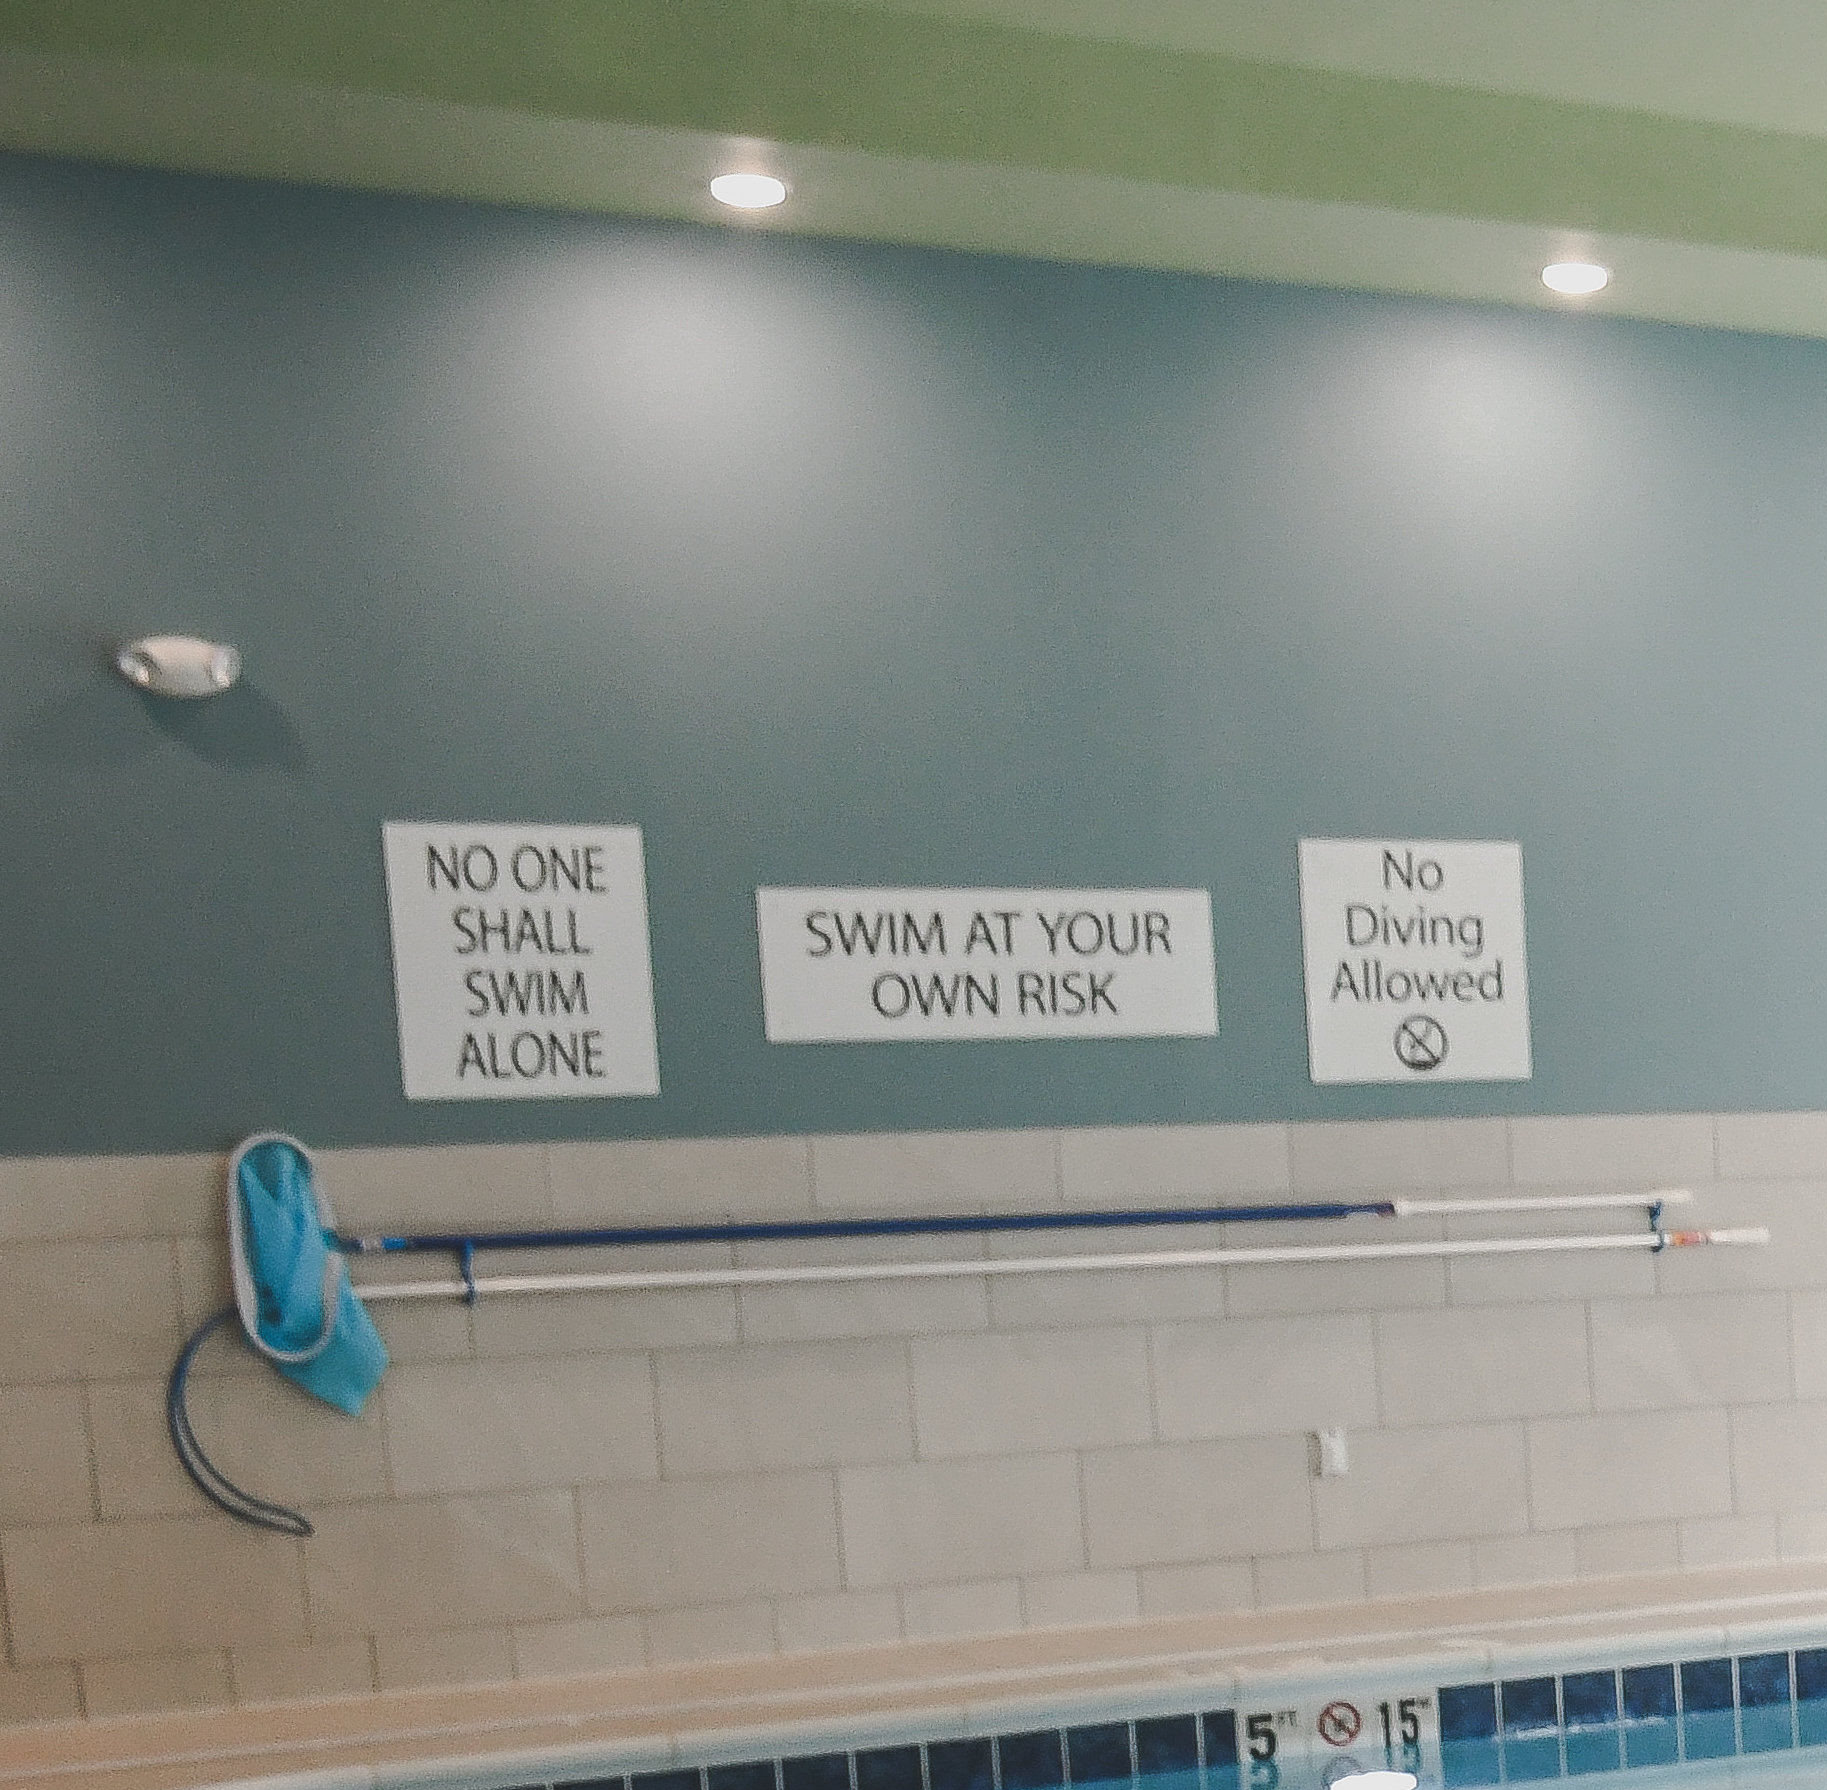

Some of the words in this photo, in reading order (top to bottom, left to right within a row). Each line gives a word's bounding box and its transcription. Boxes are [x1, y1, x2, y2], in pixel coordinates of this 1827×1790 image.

[427, 845, 498, 892] NO
[511, 845, 606, 893] ONE
[1383, 850, 1444, 891] No
[453, 907, 590, 955] SHALL
[806, 911, 946, 957] SWIM
[966, 912, 1020, 955] AT
[1037, 911, 1171, 955] YOUR
[1346, 904, 1483, 958] Diving
[465, 970, 588, 1017] SWIM
[872, 974, 998, 1018] OWN
[1018, 972, 1117, 1015] RISK
[1331, 957, 1503, 1002] Allowed
[458, 1031, 604, 1078] ALONE
